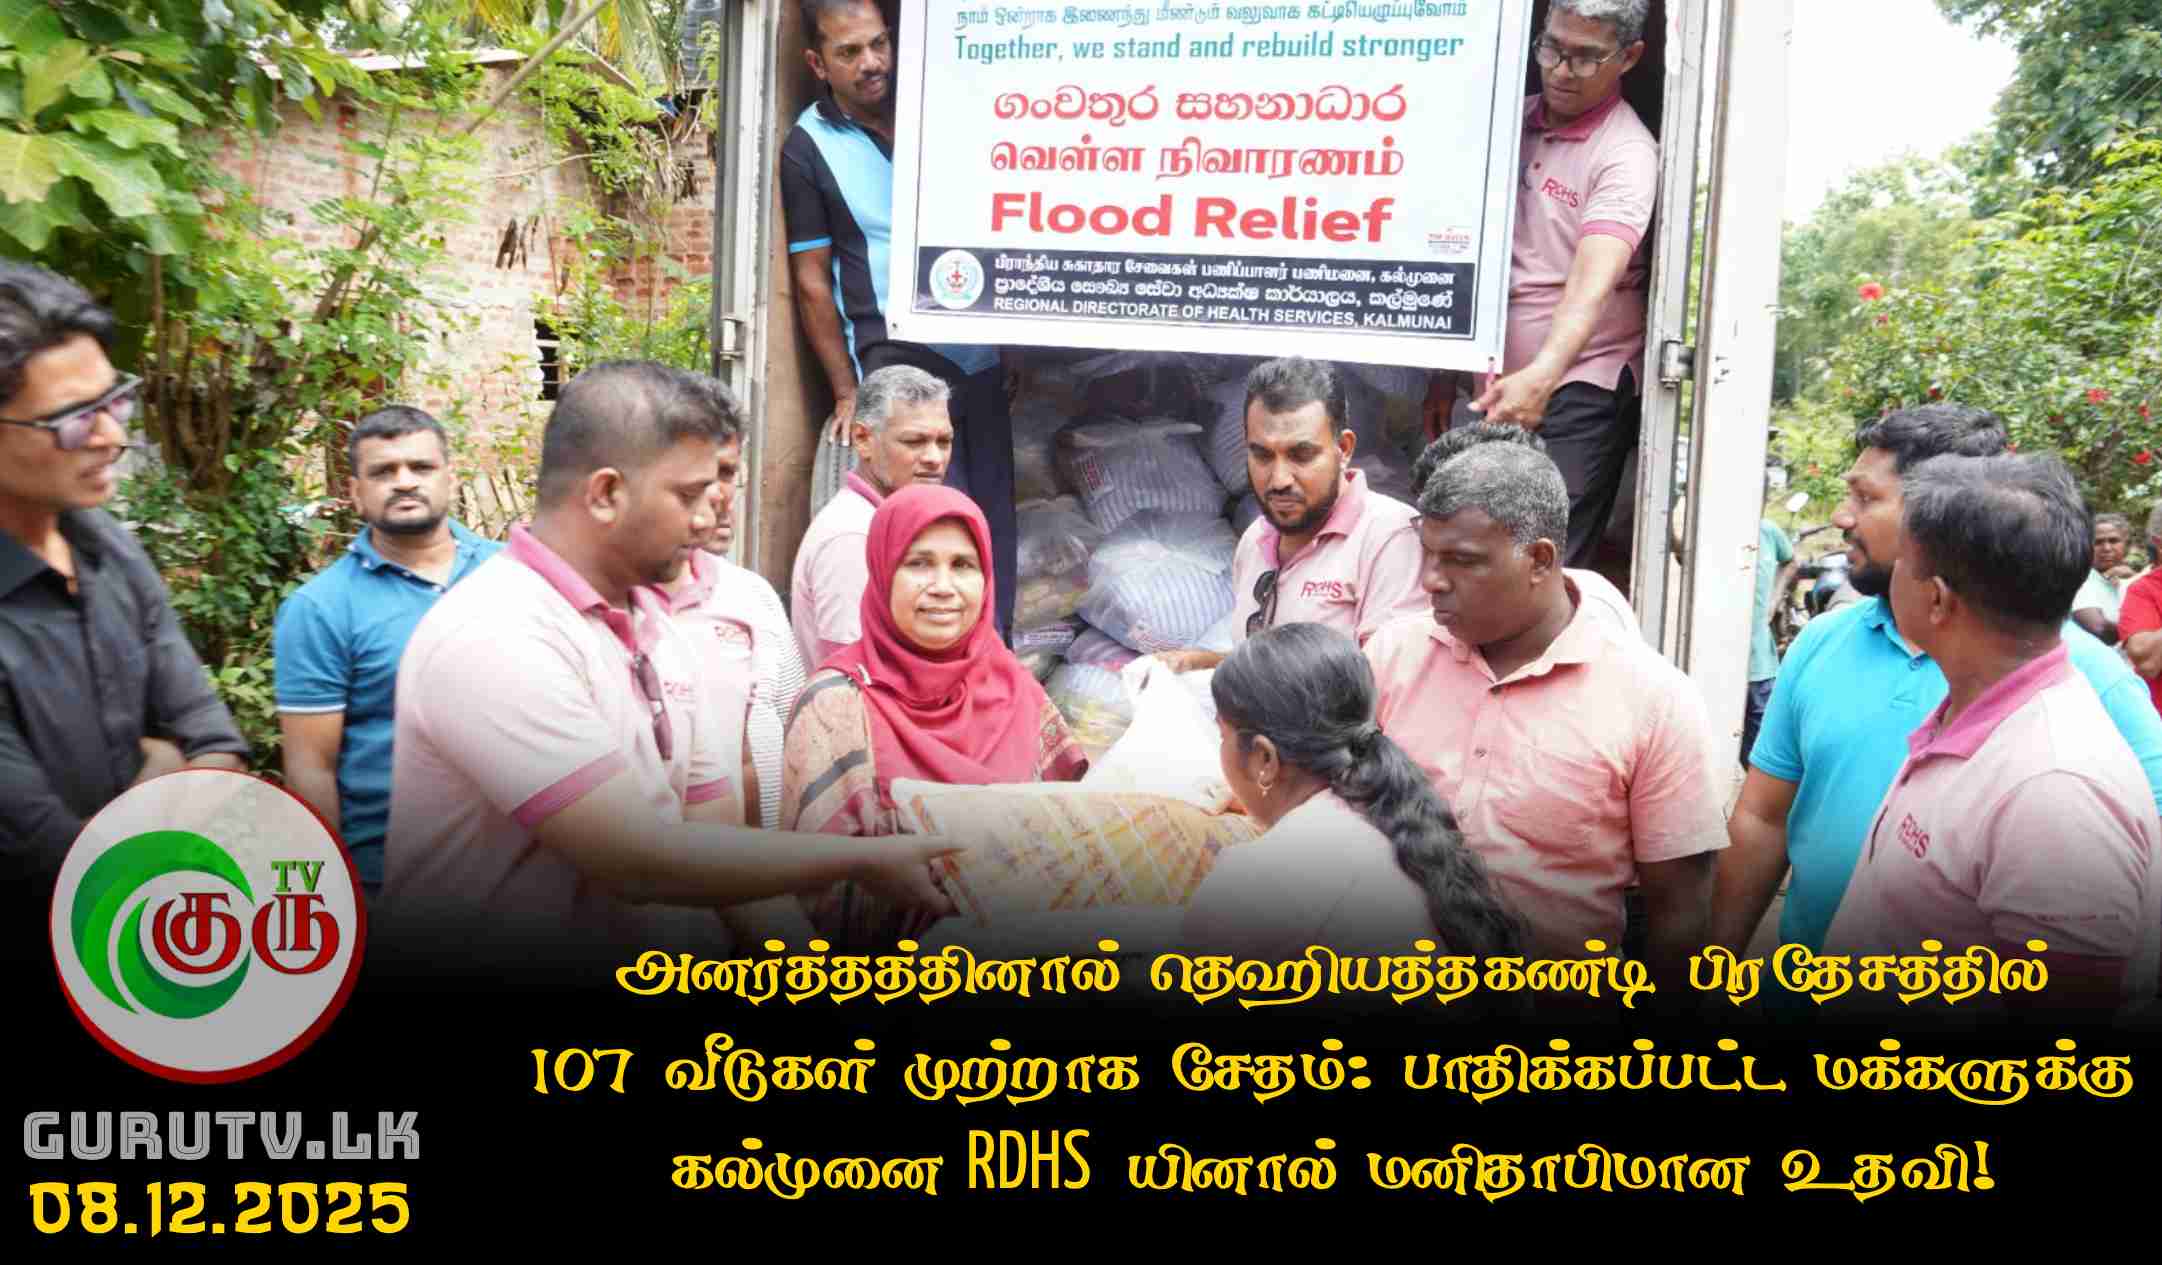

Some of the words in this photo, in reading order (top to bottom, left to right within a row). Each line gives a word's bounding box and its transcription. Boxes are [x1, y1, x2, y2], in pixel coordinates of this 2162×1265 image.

[955, 35, 1063, 64] Together,
[1072, 41, 1105, 59] we
[1113, 32, 1181, 58] stand
[1189, 32, 1235, 58] and
[1242, 31, 1333, 58] rebuild
[1342, 34, 1465, 62] stronger
[994, 85, 1159, 127] ගංවතුර
[1176, 84, 1407, 121] සහනාධාර
[991, 133, 1146, 171] வெள்ள
[1155, 136, 1404, 180] நிவாரணம்
[992, 191, 1173, 237] Flood
[1194, 196, 1394, 243] Relief
[993, 297, 1069, 314] REGIONAL
[1072, 300, 1179, 319] DIRECTORATE
[1182, 304, 1204, 320] OF
[1207, 305, 1270, 322] HEALTH
[1273, 308, 1360, 328] SERVICES,
[1363, 312, 1453, 330] KALMUNAI
